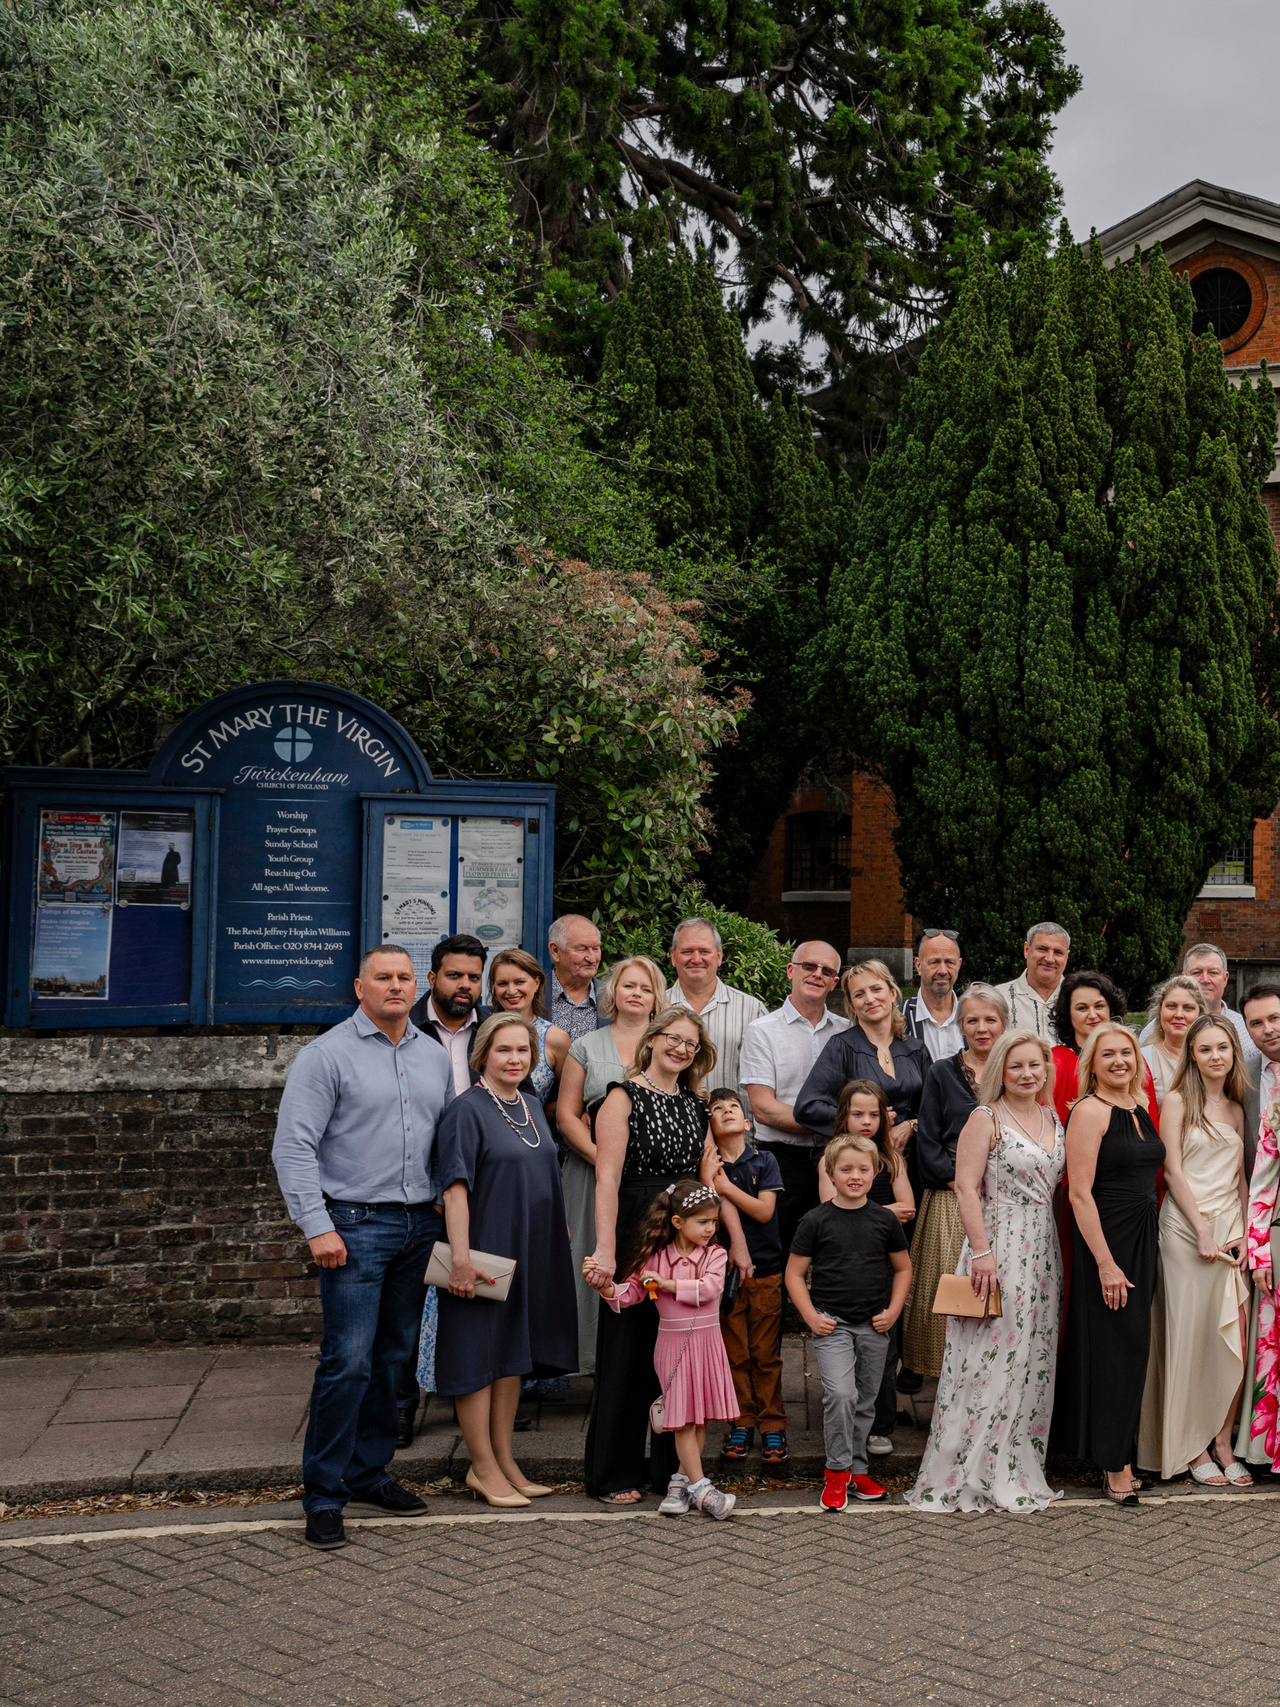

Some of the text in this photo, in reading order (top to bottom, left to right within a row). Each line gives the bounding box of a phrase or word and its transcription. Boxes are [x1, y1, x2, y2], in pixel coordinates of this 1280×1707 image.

[180, 704, 400, 778] ST MARY THE VIRGIN
[233, 765, 351, 787] Twickenham
[256, 782, 286, 790] CHURCH
[276, 811, 308, 822] Worship
[266, 825, 317, 836] Prayer Groups
[264, 840, 318, 850] Sunday School
[268, 854, 314, 865] Youth Group
[264, 868, 300, 879] Reaching
[251, 883, 329, 894] All ages. All welcome.
[268, 913, 314, 922] Parish Priest:
[226, 926, 241, 936] The
[242, 928, 263, 936] Revd.
[263, 928, 288, 937] Jeffrey
[288, 928, 318, 938] Hopkin
[234, 942, 255, 950] Parish
[256, 942, 282, 950] Office:
[303, 942, 322, 950] 8744
[324, 943, 343, 951] 2693
[242, 957, 334, 968] www.stmarytwick.org.uk
